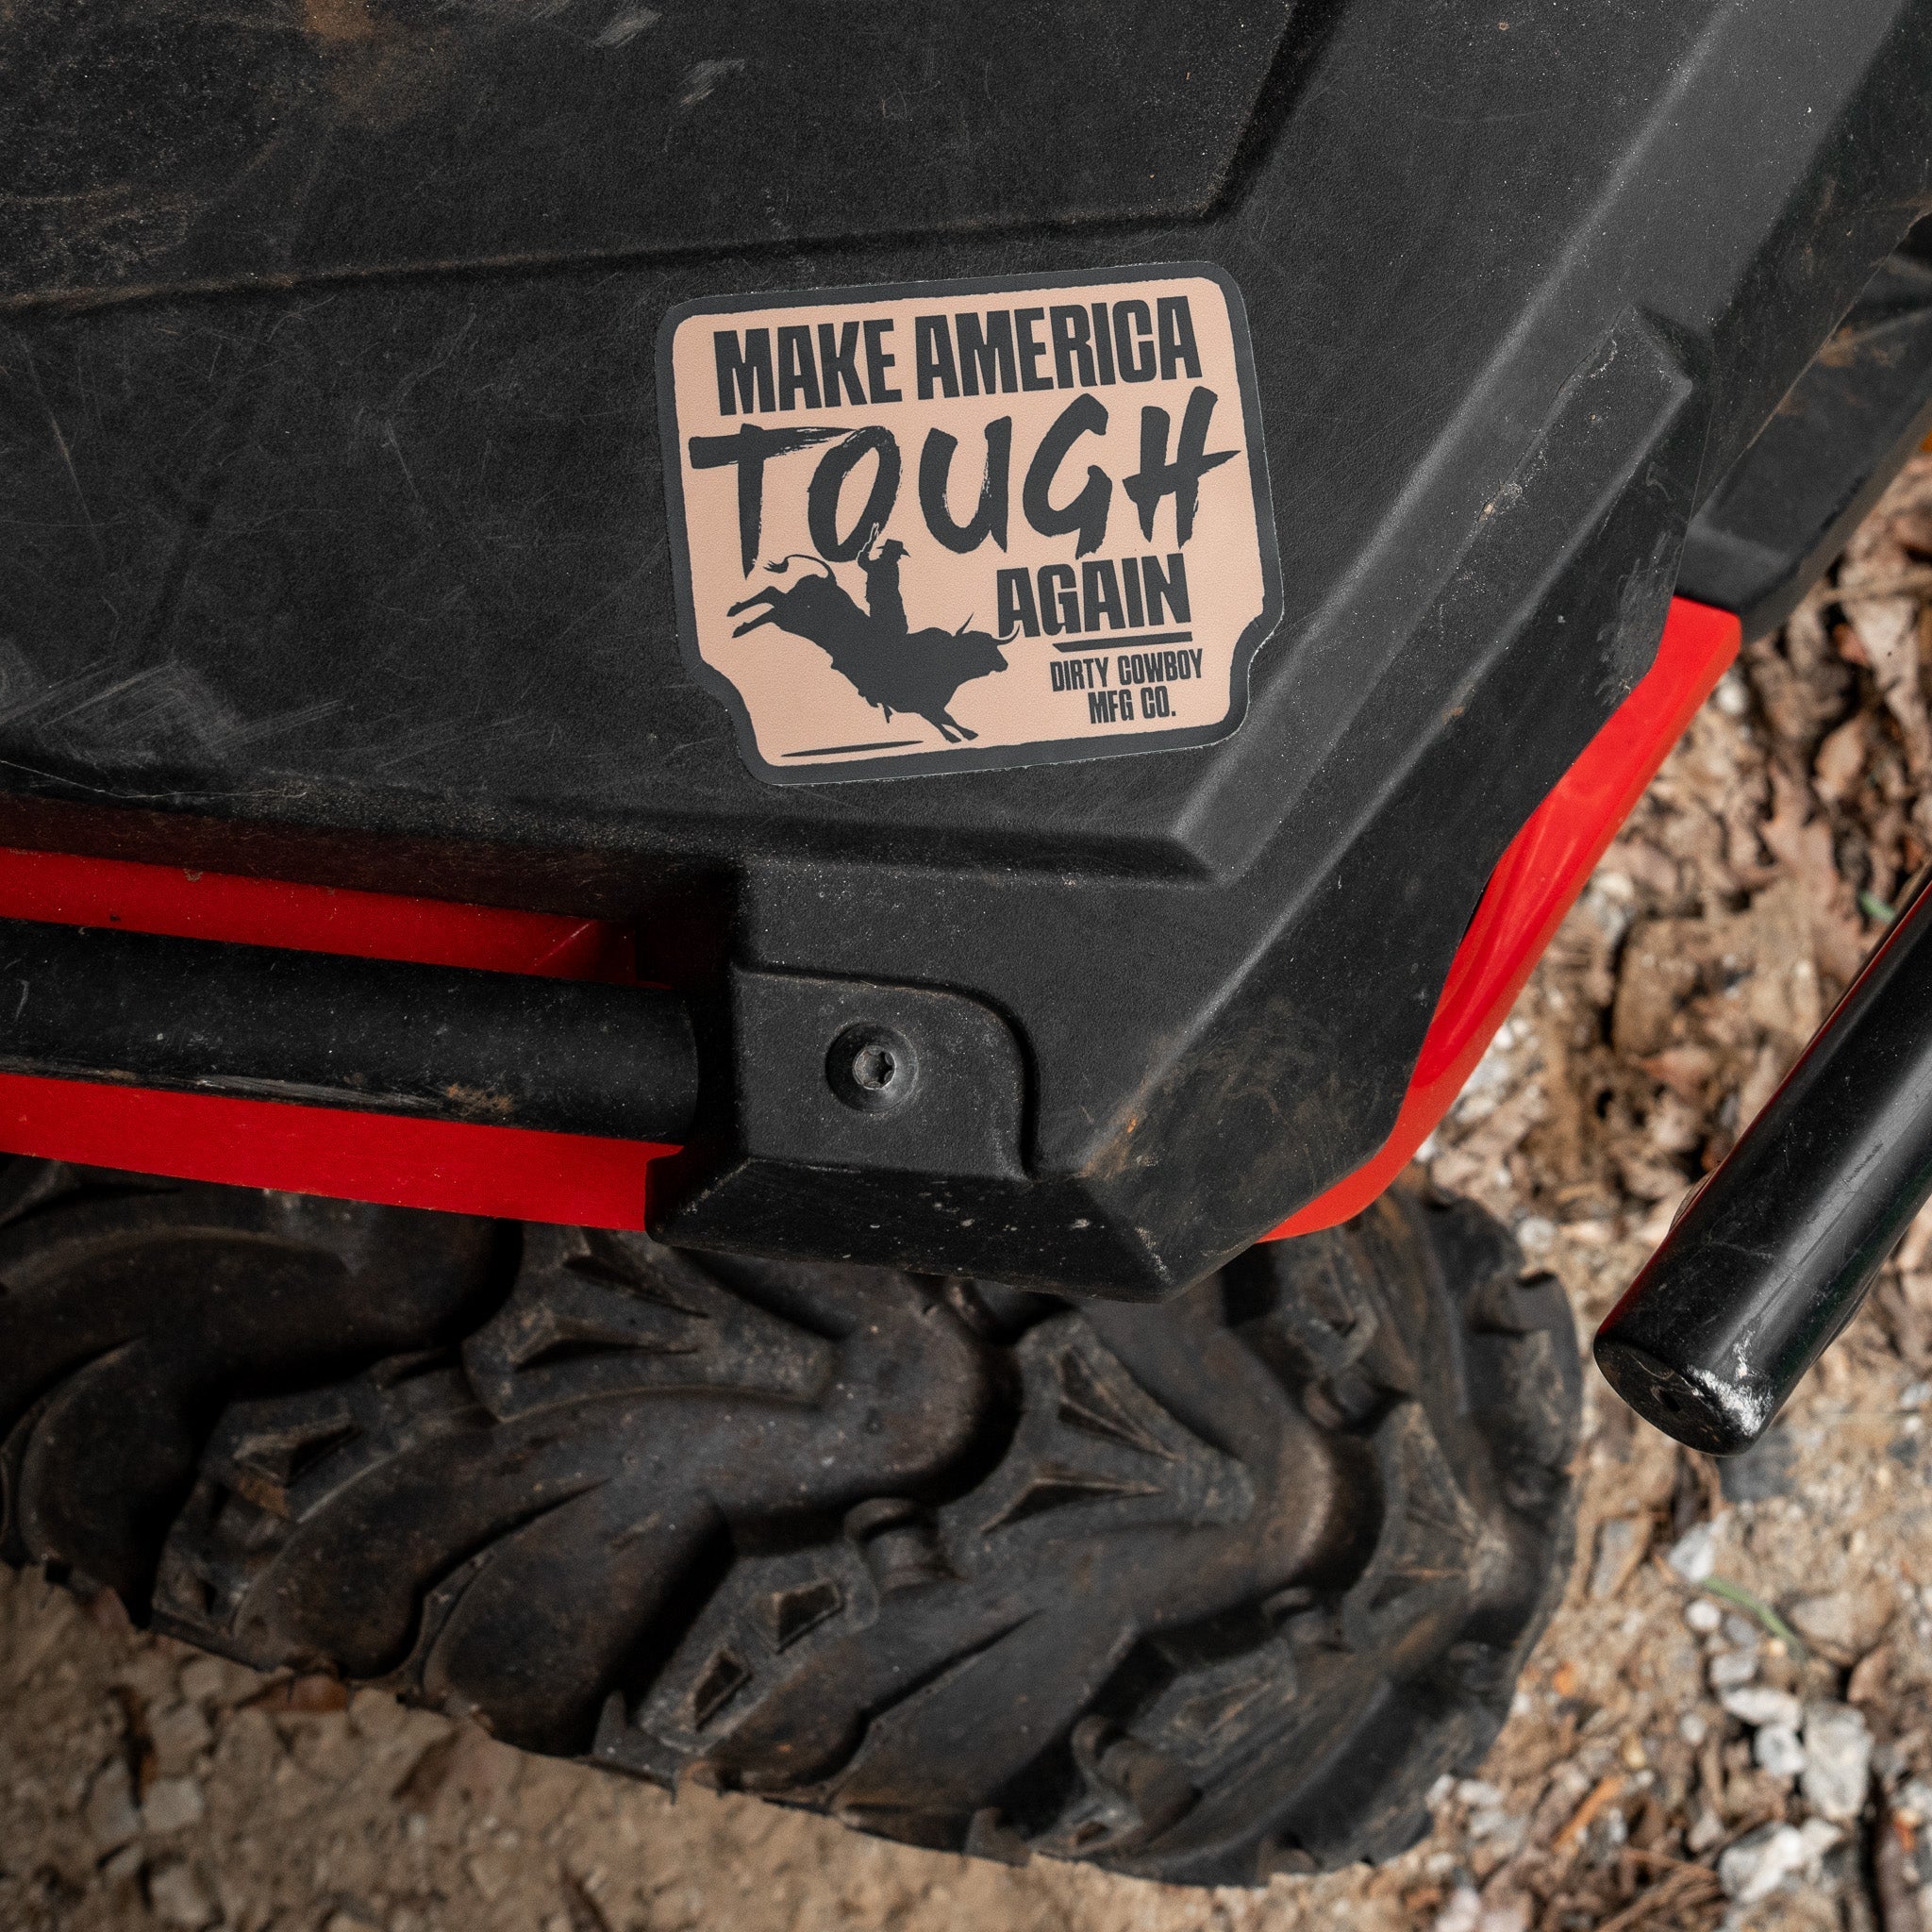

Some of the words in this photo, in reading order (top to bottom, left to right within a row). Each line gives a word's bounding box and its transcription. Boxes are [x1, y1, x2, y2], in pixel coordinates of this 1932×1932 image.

[713, 319, 903, 416] MAKE
[914, 295, 1203, 401] AMERICA
[689, 385, 1241, 580] TOUGH
[995, 553, 1192, 639] AGAIN
[1049, 656, 1109, 692] DIRTY
[1116, 648, 1204, 685] COWBOY
[1088, 689, 1135, 724] MFG
[1141, 684, 1177, 719] CO.
